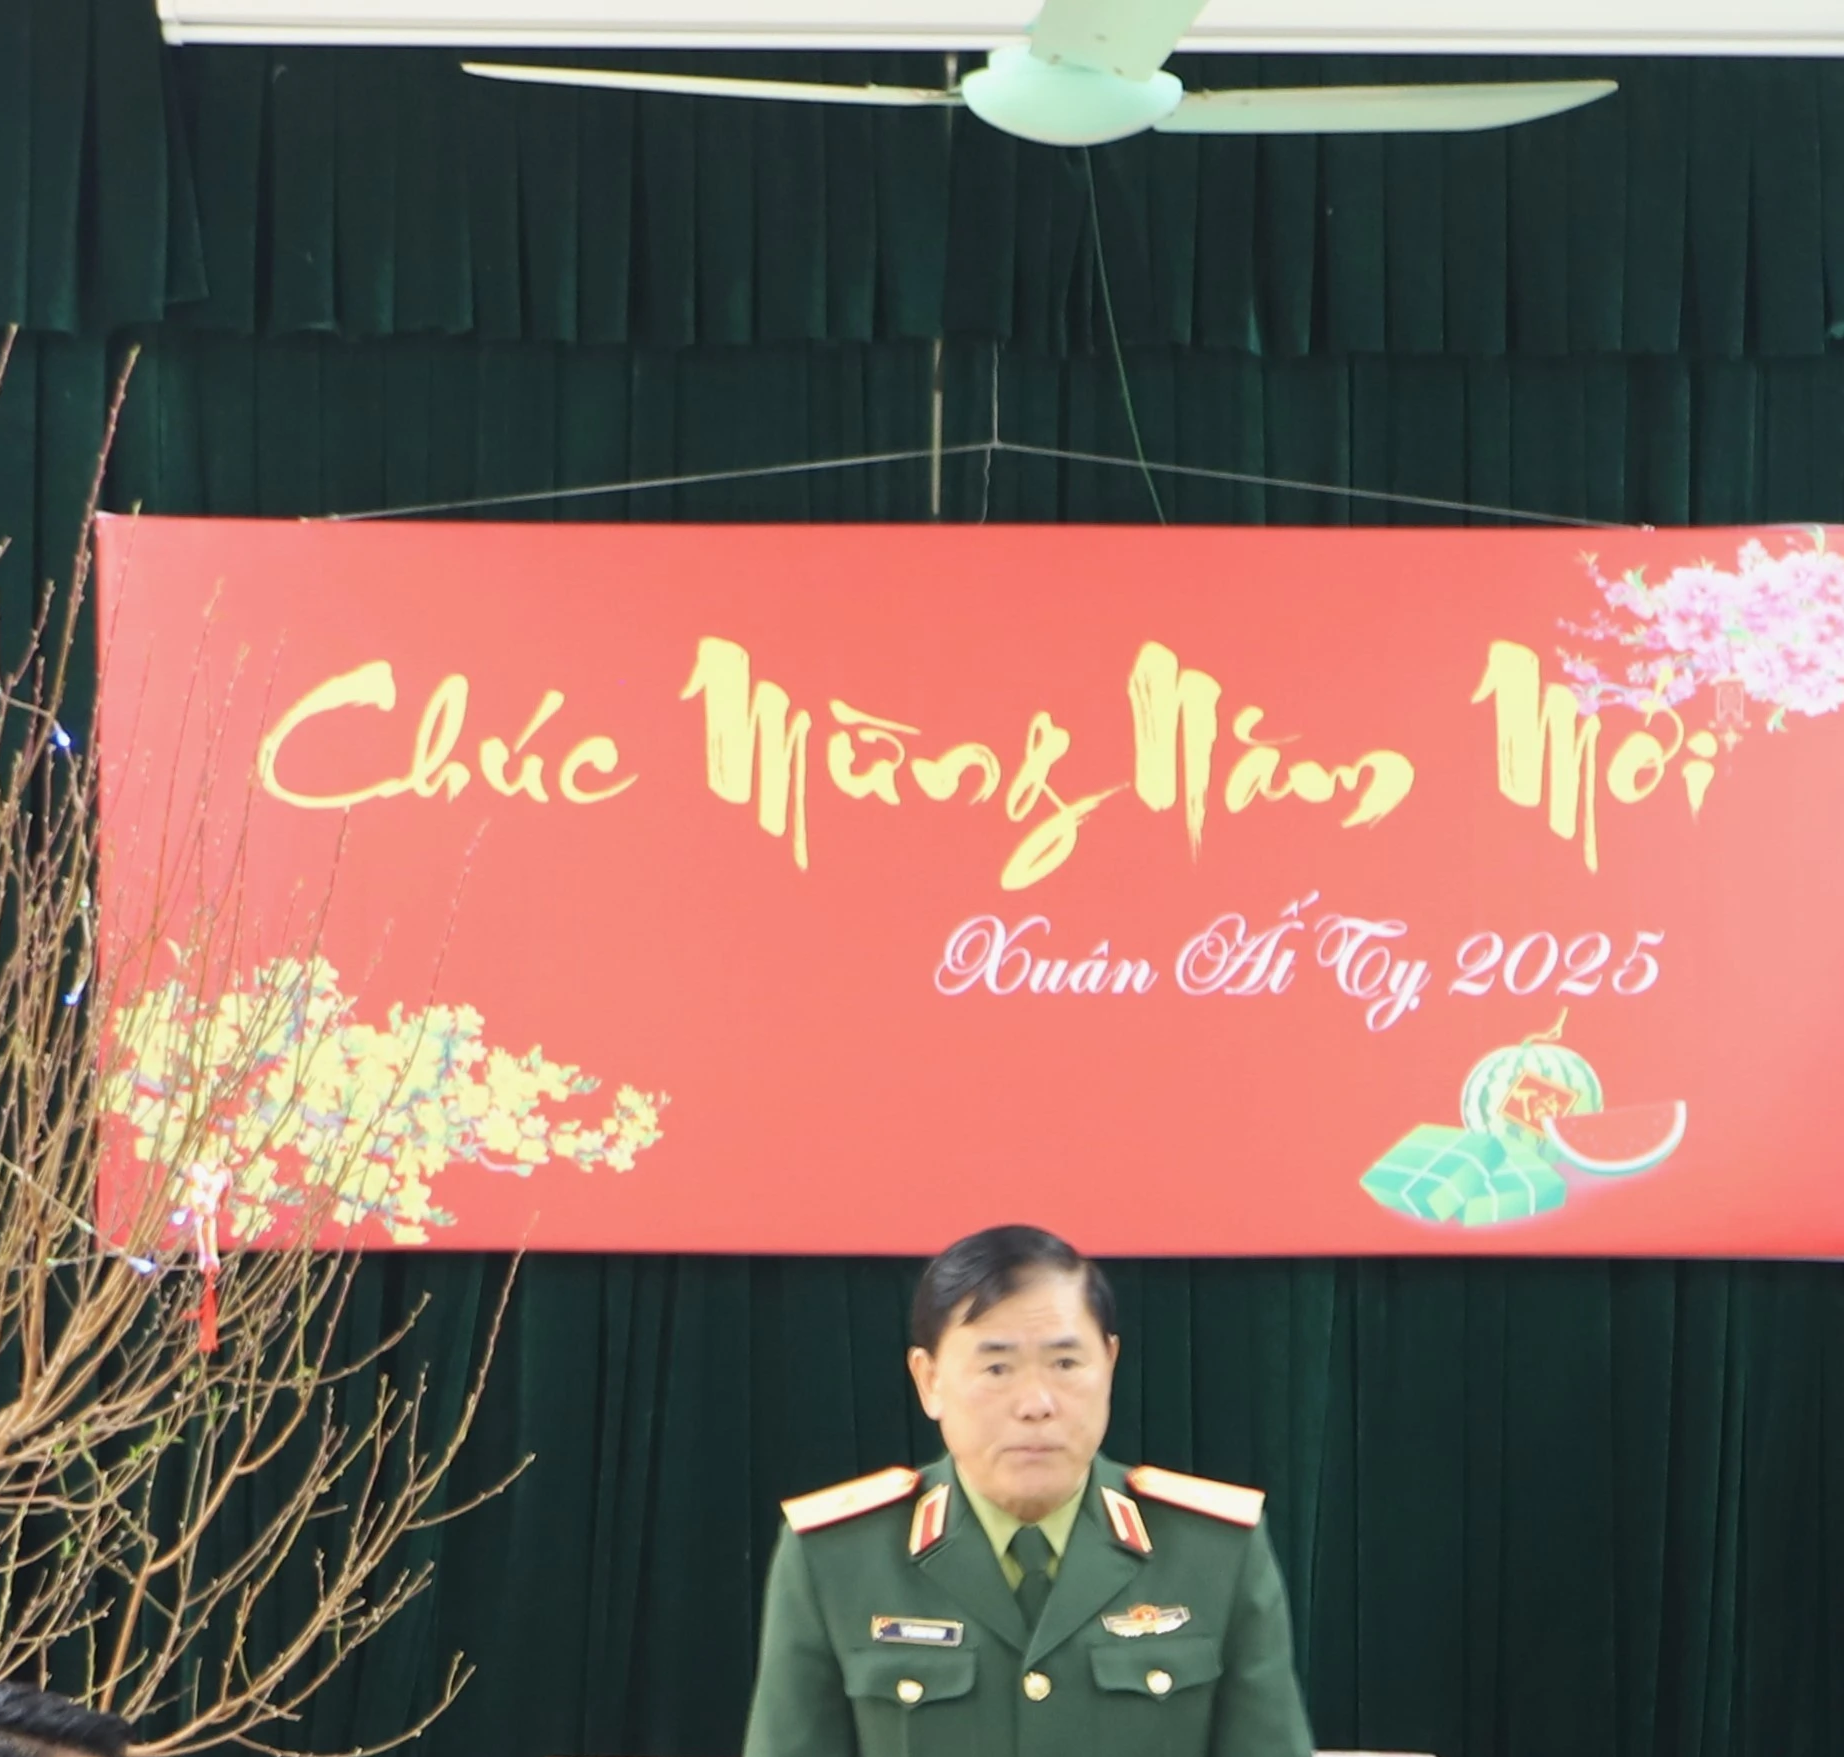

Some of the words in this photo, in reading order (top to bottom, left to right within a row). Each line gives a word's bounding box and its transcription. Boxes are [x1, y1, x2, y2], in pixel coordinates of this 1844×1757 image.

[258, 660, 639, 812] Chúc
[679, 635, 1131, 892] Mừng
[1127, 640, 1415, 864] Năm
[1470, 639, 1719, 877] Mới
[933, 912, 1159, 996] Xuân
[1314, 913, 1433, 1033] Tỵ
[1447, 929, 1666, 997] 2025
